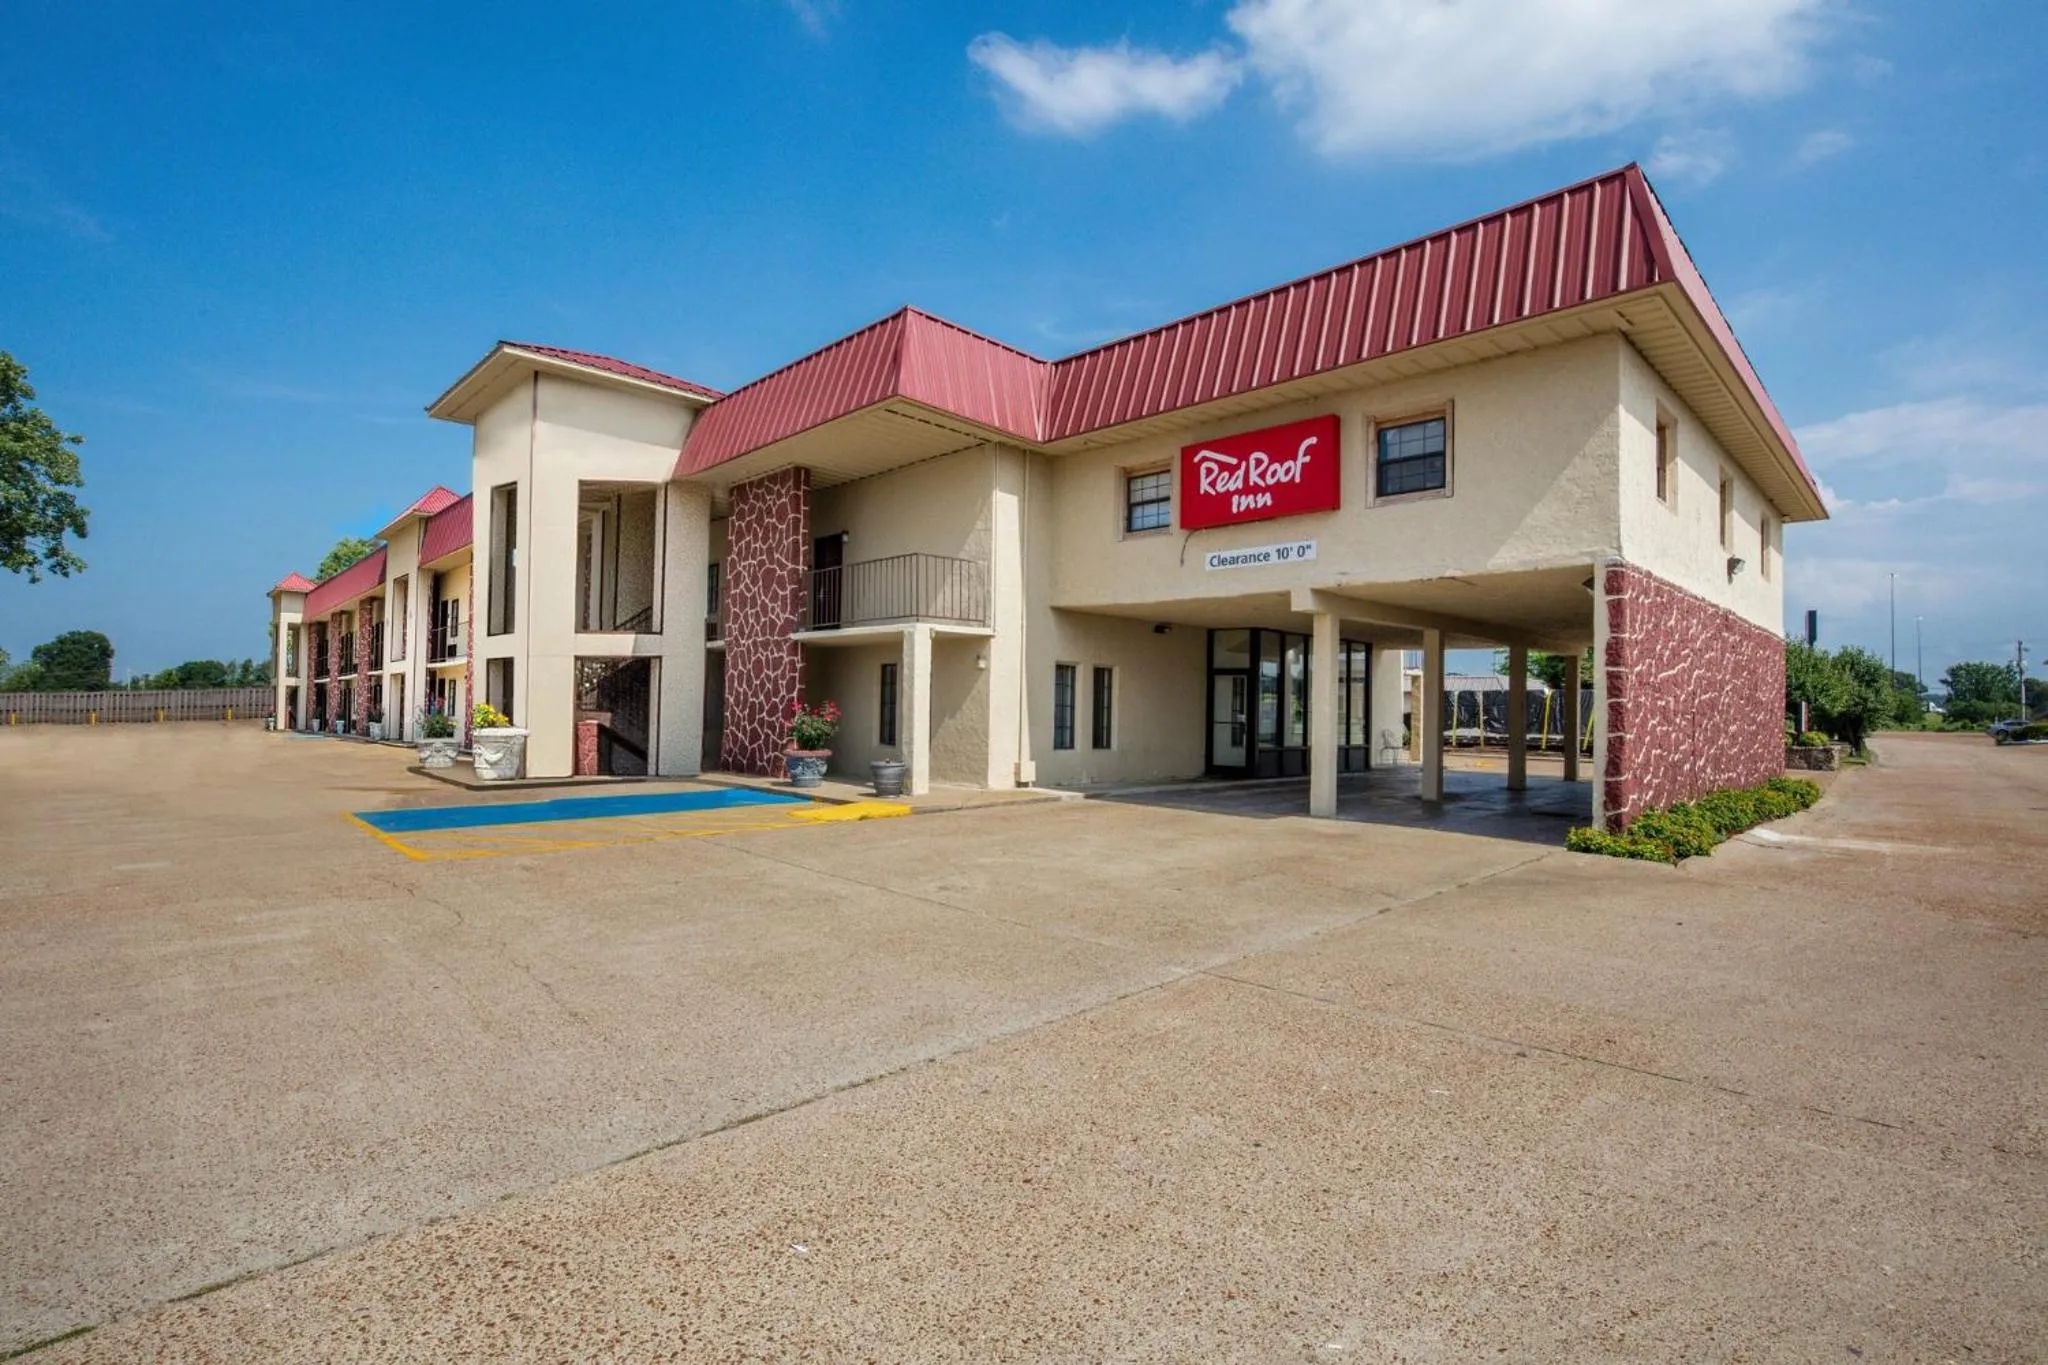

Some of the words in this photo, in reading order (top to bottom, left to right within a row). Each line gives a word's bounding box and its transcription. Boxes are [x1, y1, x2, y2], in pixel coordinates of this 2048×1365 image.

[1200, 460, 1246, 495] Red
[1249, 436, 1318, 487] Roof
[1209, 552, 1271, 568] Clearance
